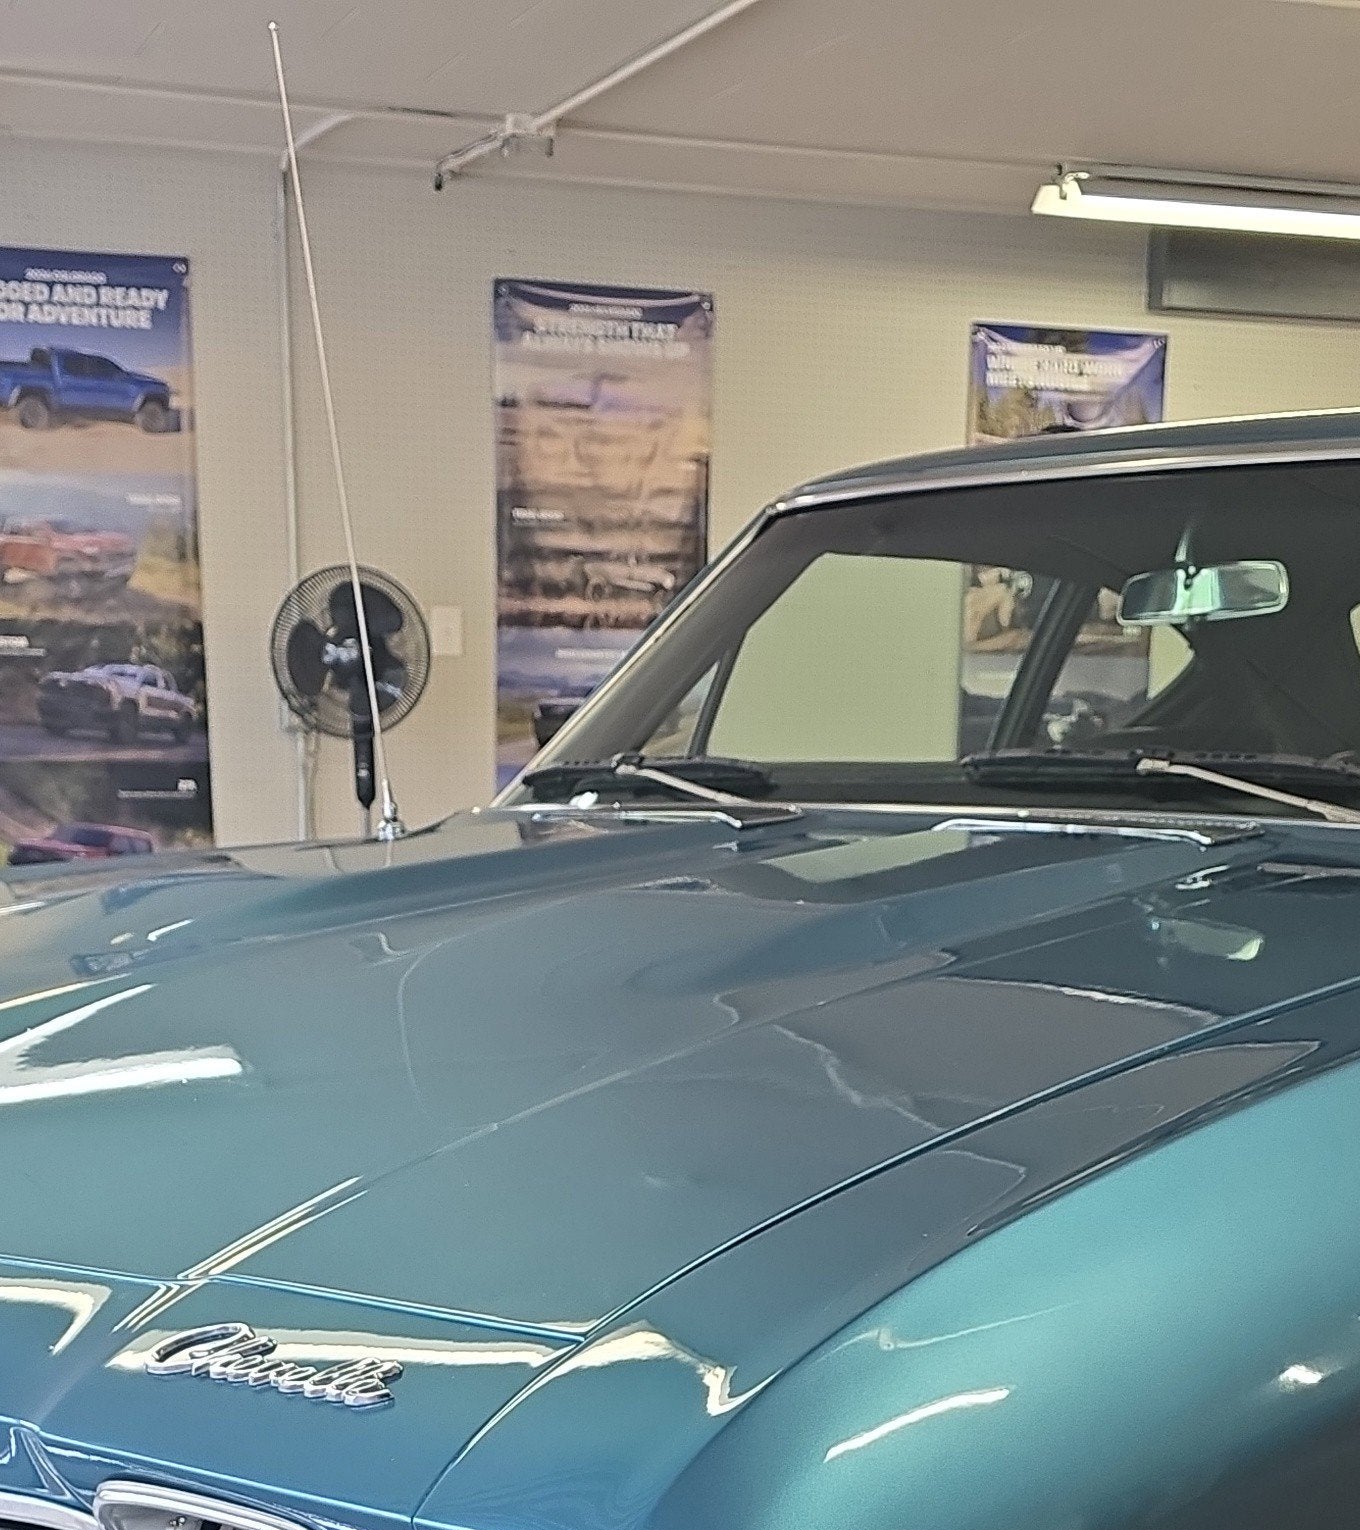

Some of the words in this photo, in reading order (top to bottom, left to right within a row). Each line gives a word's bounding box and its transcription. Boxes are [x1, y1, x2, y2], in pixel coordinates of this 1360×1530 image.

[51, 283, 97, 305] AND
[98, 286, 169, 311] READY
[27, 302, 153, 330] ADVENTURE
[144, 1322, 403, 1407] Chevelle
